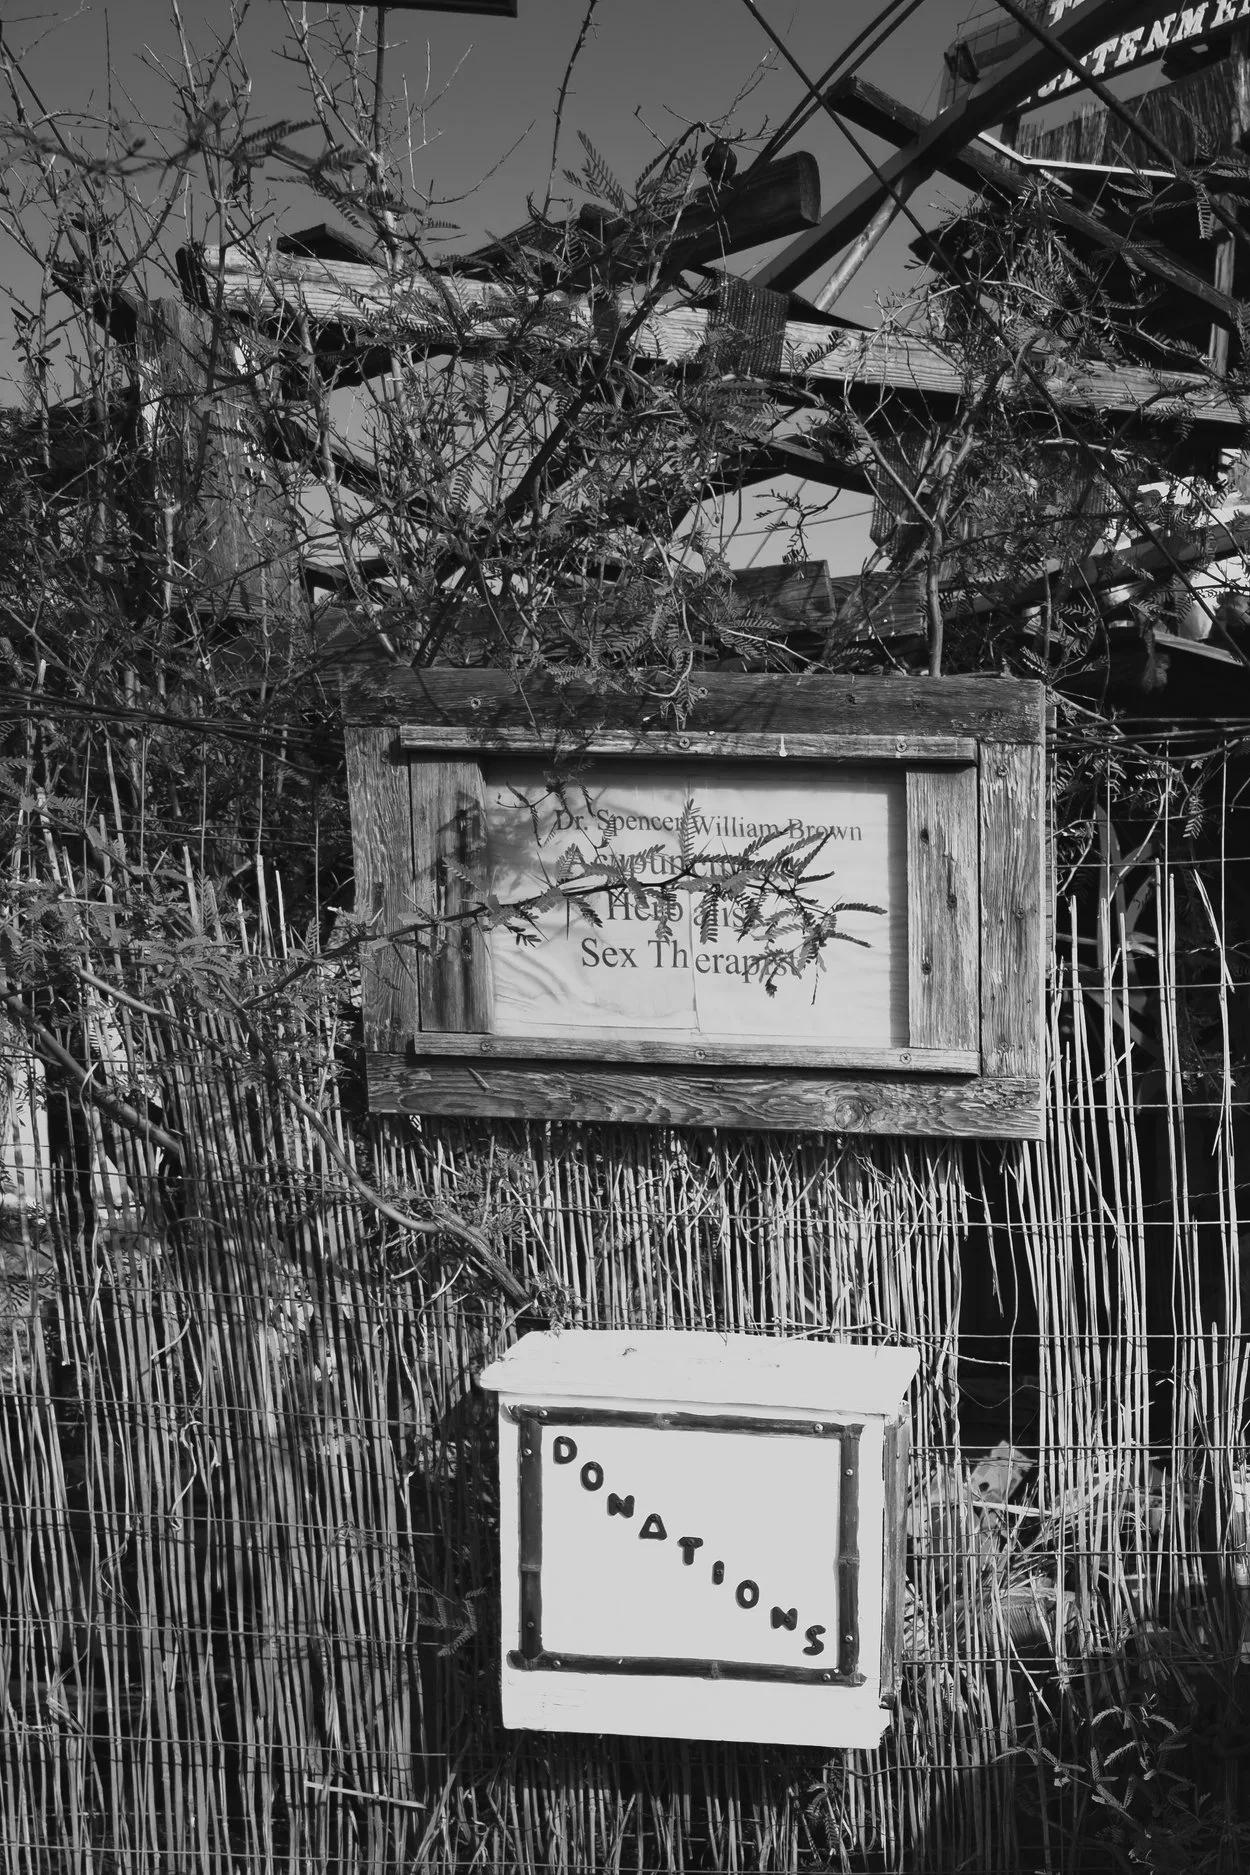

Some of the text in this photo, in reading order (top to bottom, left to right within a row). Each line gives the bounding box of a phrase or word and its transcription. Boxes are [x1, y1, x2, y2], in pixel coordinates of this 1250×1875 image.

[555, 809, 862, 841] Dr. Spencer William Brown
[581, 938, 800, 984] Sex Therapist
[552, 1436, 827, 1656] DONATIONS
